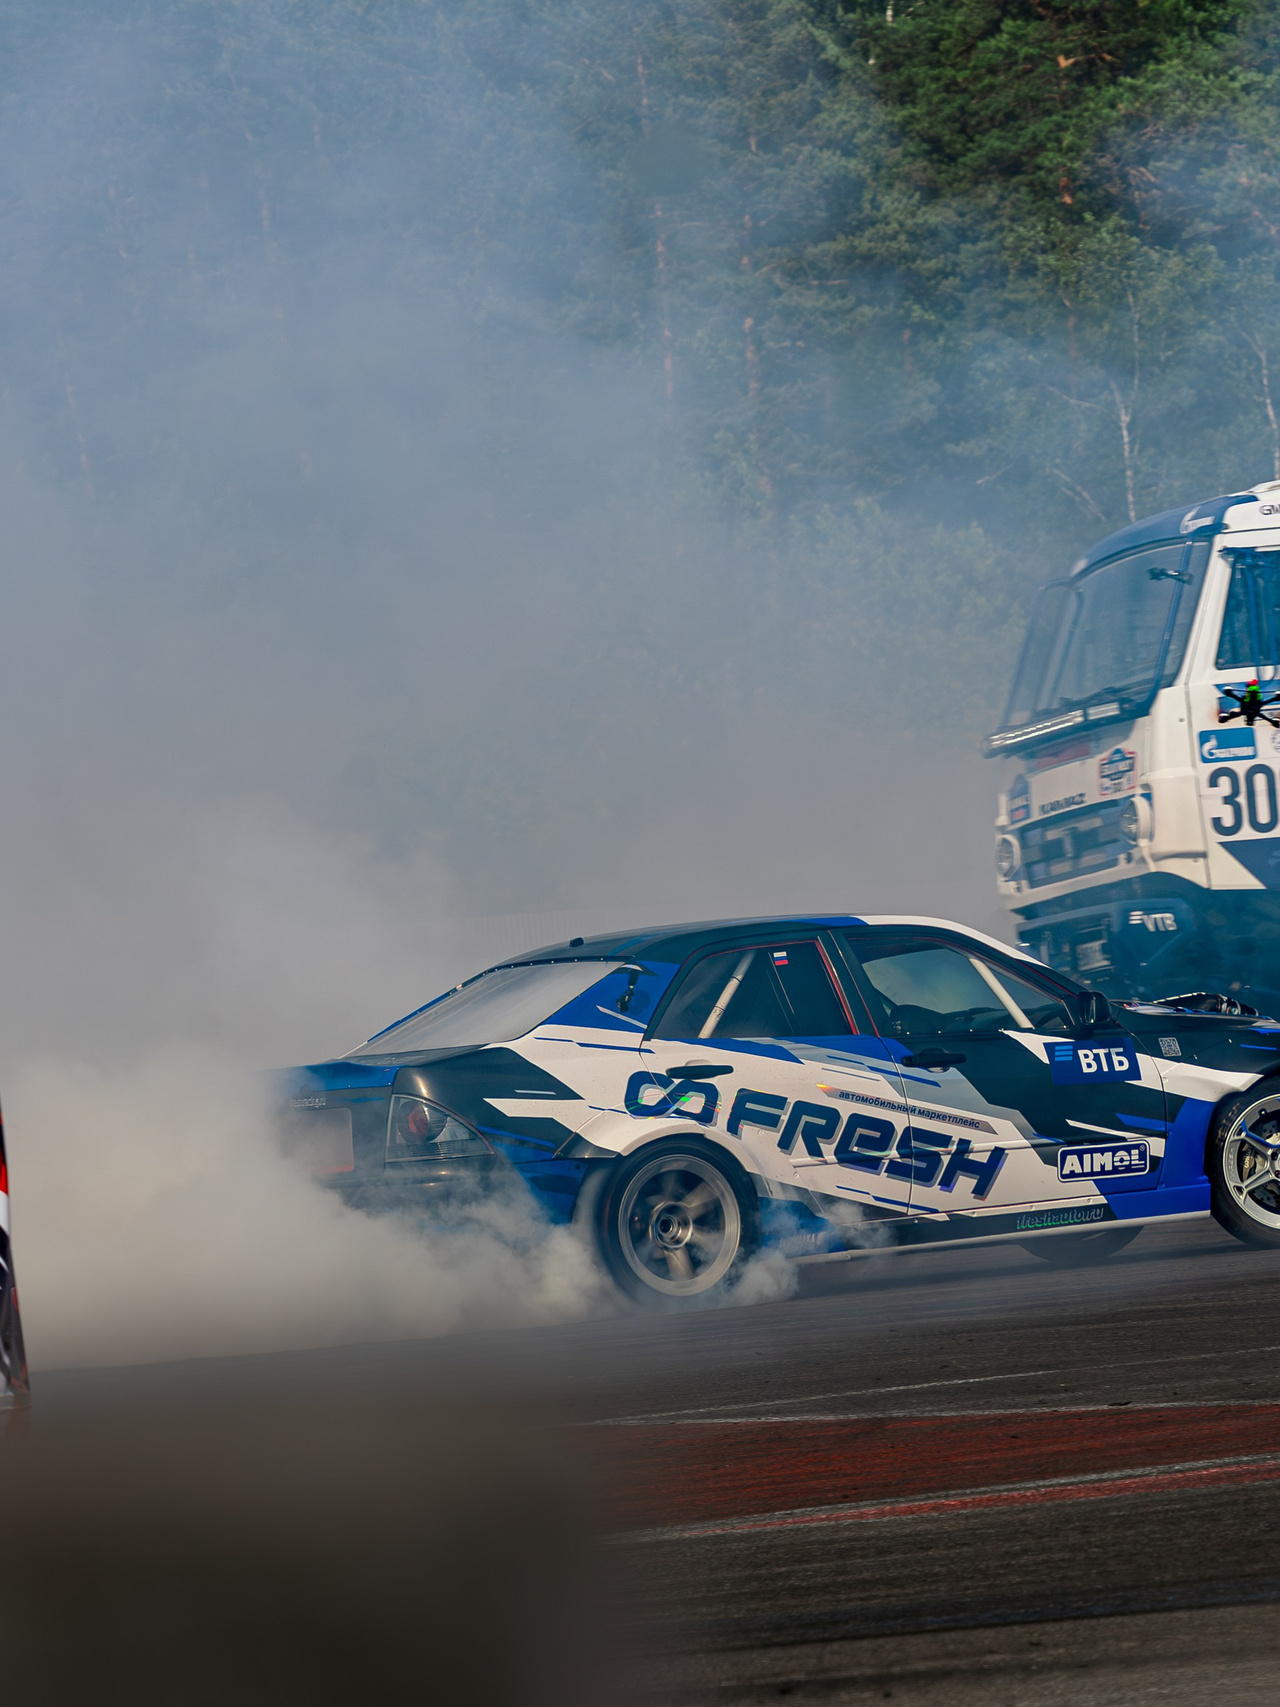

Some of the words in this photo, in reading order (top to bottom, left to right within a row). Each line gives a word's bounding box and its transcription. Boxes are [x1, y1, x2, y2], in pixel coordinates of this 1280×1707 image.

[1142, 912, 1178, 932] VTB
[1077, 1047, 1130, 1074] ВТБ
[838, 1090, 917, 1116] автомобильный
[917, 1108, 981, 1130] маркетплейс
[1061, 1149, 1146, 1175] AIMOL
